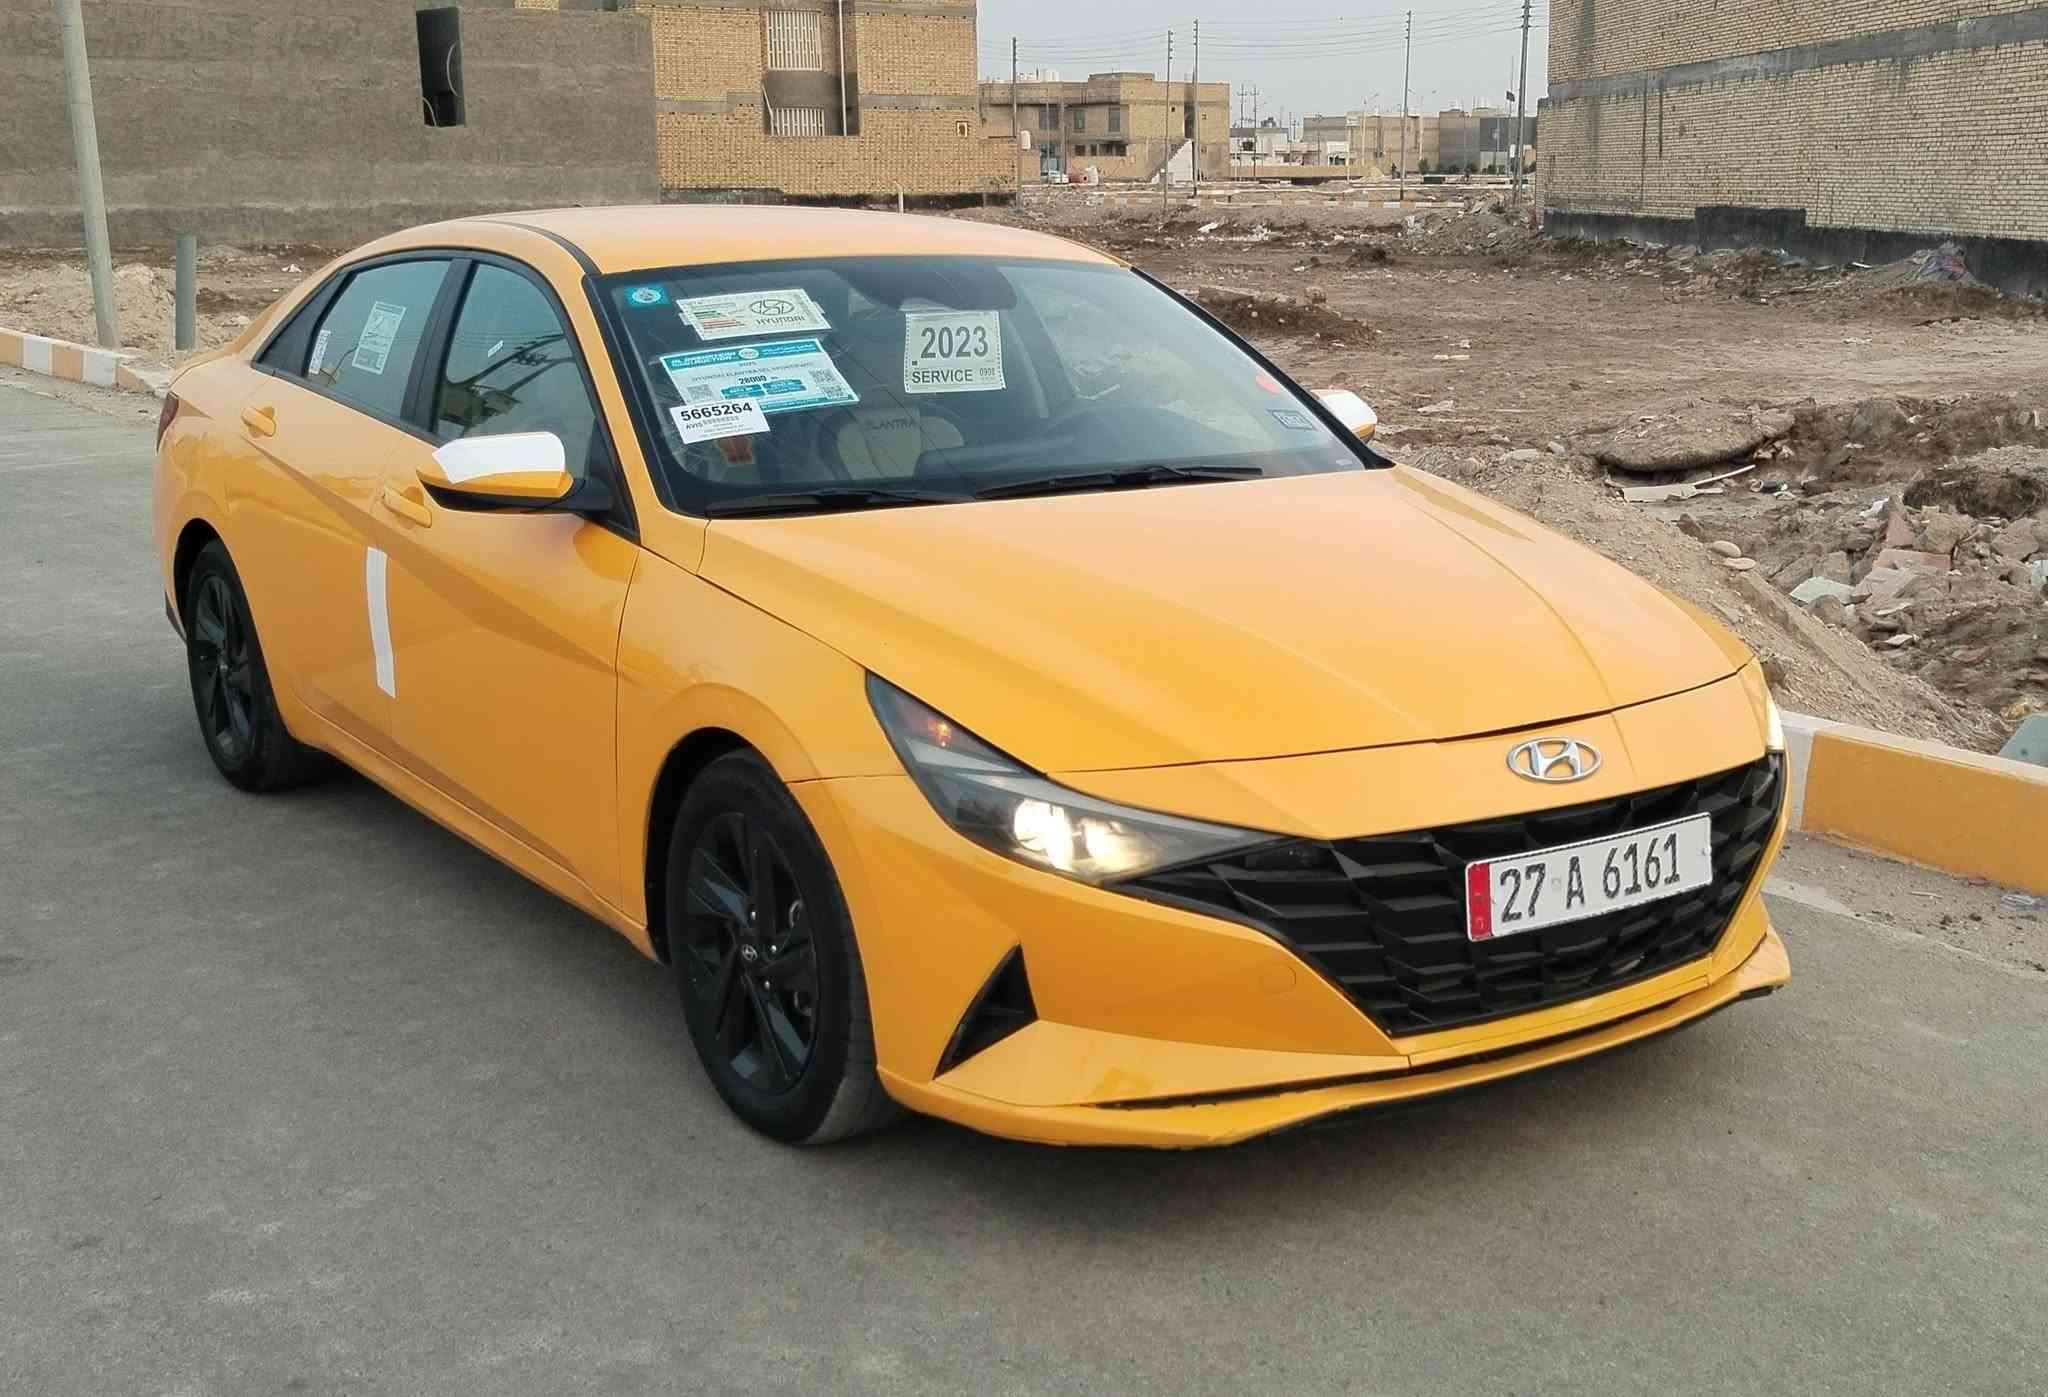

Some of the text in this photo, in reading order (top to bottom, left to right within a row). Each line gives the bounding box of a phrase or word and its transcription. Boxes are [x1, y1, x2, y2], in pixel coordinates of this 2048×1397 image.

[920, 326, 989, 359] 2023
[911, 369, 973, 384] SERVICE
[681, 402, 752, 421] 5665264
[1499, 833, 1681, 922] 27 A 6161
